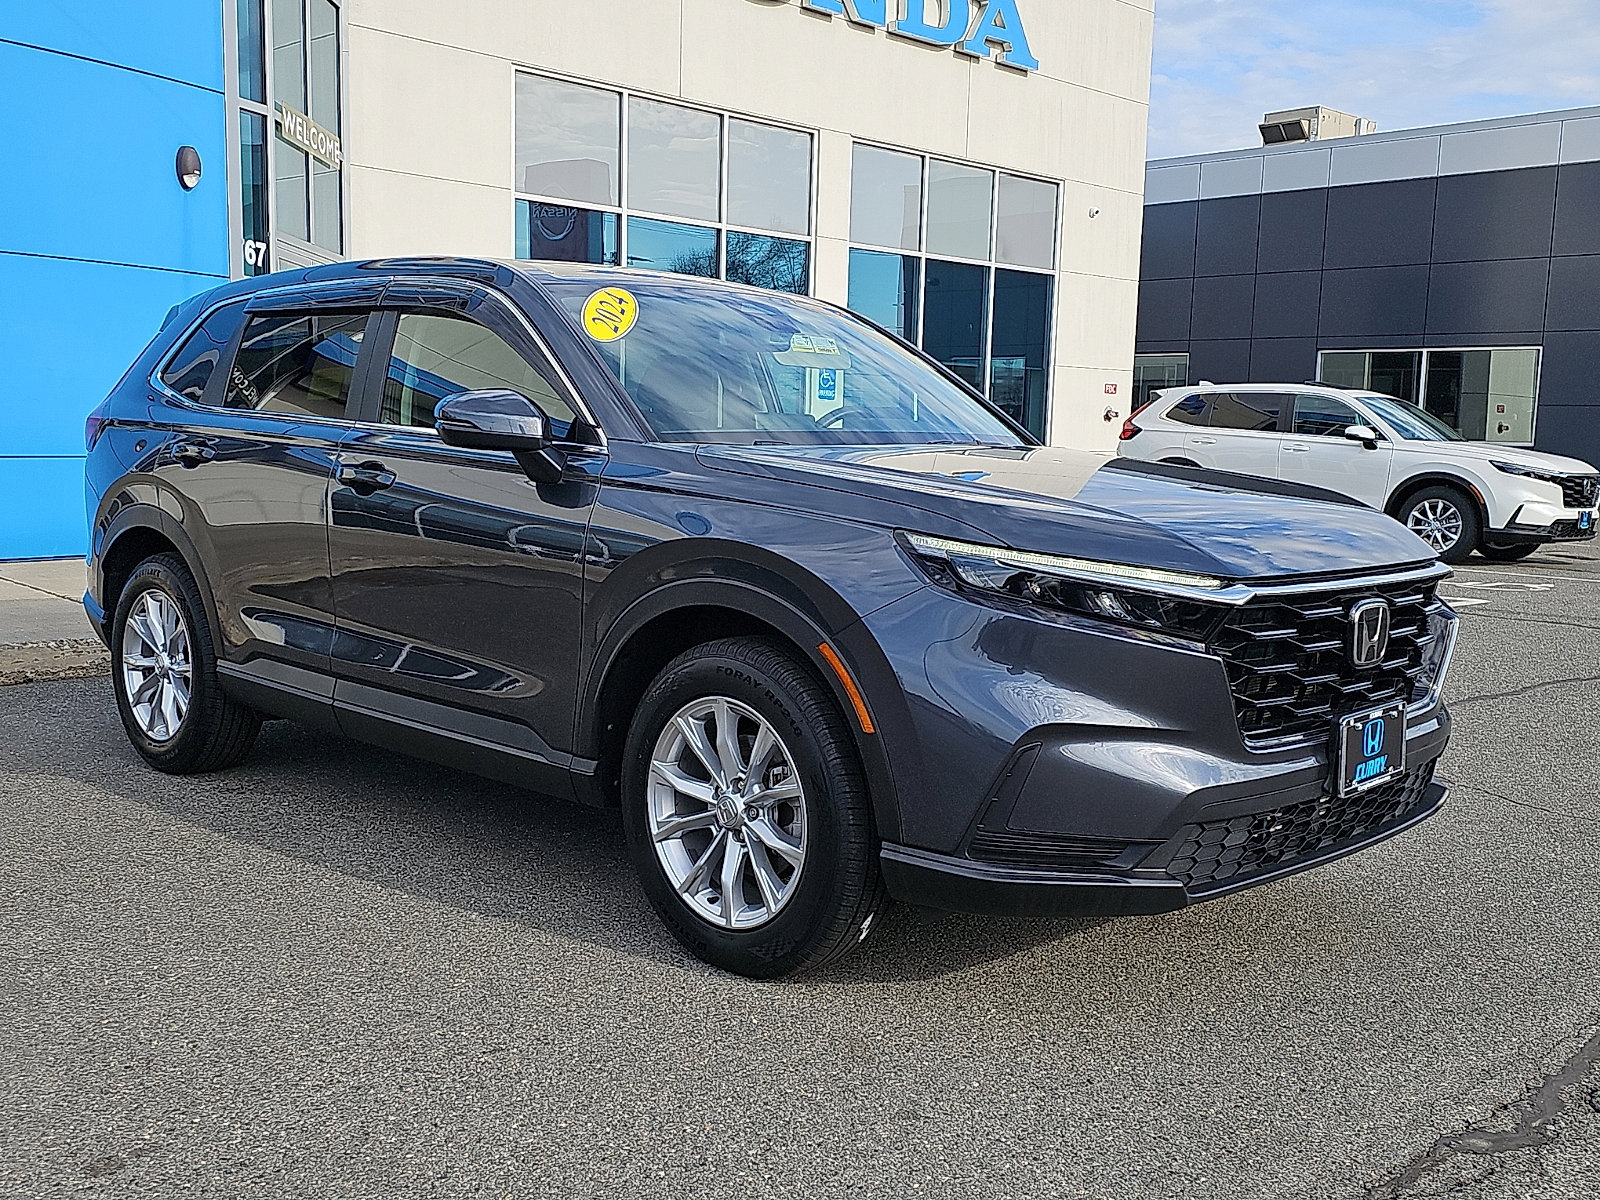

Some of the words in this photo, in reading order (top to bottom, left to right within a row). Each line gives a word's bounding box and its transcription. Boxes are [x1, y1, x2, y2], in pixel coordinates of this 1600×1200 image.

[282, 107, 340, 165] WELCOME
[591, 290, 629, 334] 2024
[716, 666, 762, 689] FORAY
[1355, 755, 1388, 781] CURRY
